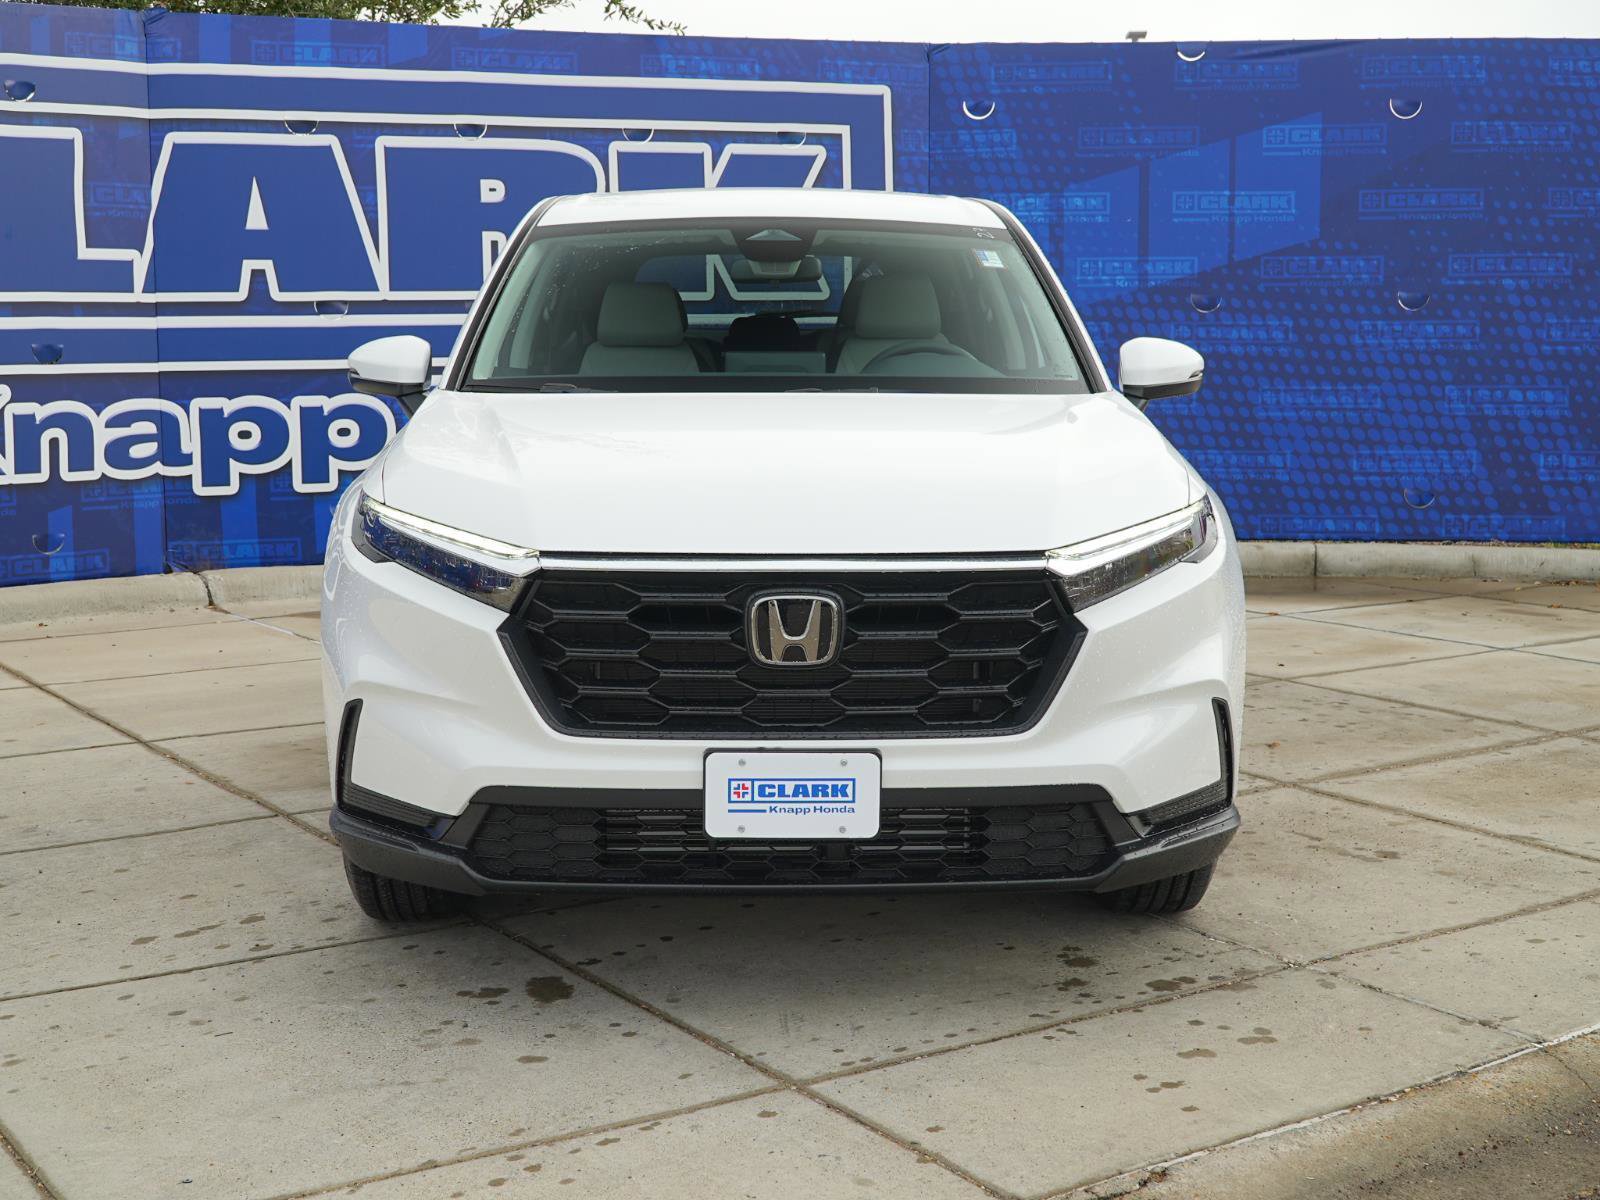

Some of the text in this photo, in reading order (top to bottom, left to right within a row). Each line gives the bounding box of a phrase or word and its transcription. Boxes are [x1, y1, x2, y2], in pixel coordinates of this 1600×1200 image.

[1201, 195, 1290, 209] CLARK
[0, 384, 397, 495] napp
[757, 783, 850, 798] CLARK
[768, 805, 856, 815] Knapp Honda
